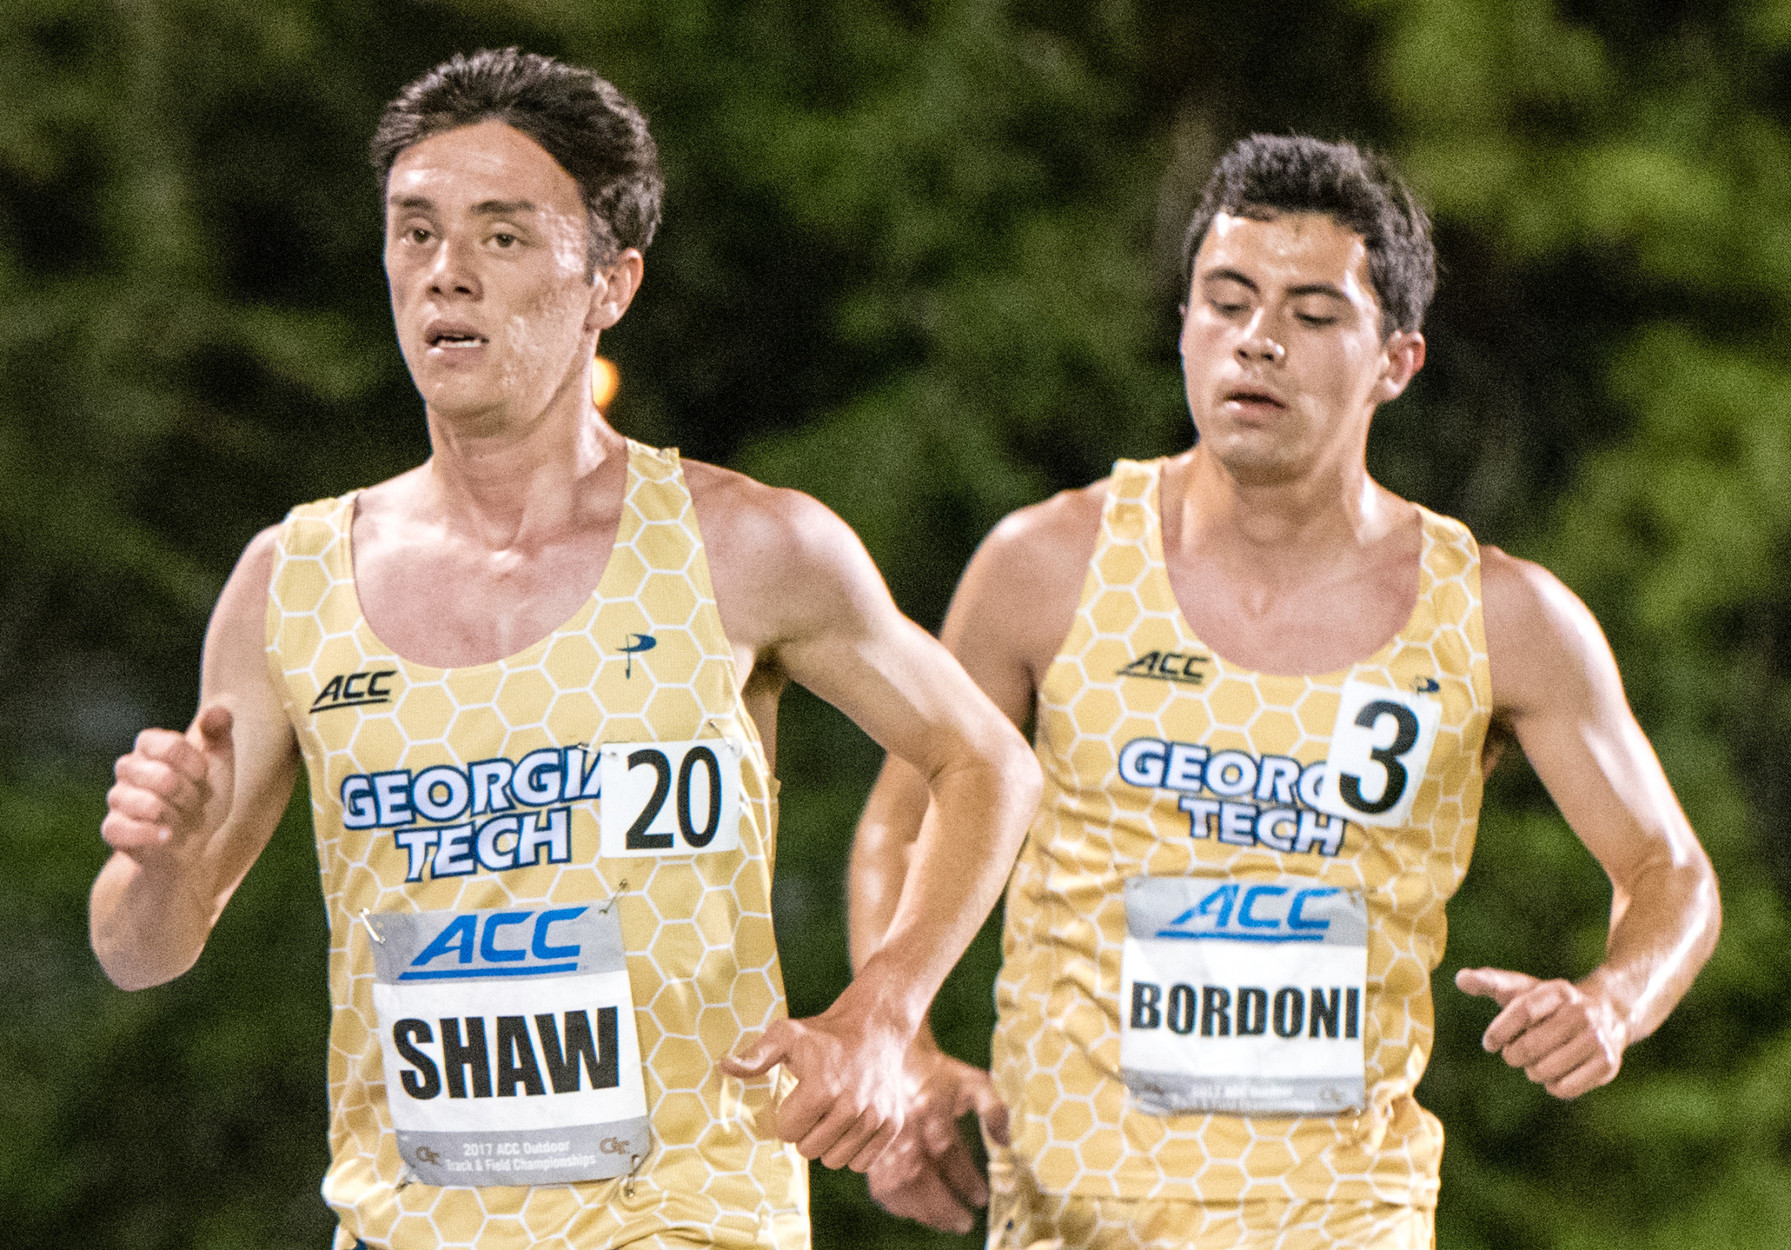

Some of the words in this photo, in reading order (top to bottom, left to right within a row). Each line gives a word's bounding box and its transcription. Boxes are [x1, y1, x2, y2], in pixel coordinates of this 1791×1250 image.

[314, 670, 397, 704] ACC
[1122, 650, 1209, 680] ACC
[1119, 737, 1329, 812] GEORG
[1339, 698, 1421, 815] 3
[625, 746, 722, 850] 20
[1179, 796, 1346, 857] TECH
[396, 803, 571, 882] TECH
[410, 906, 592, 966] ACC
[1169, 884, 1342, 931] ACC
[1129, 979, 1360, 1040] BORDONI
[392, 1006, 620, 1100] SHAW
[445, 1159, 473, 1171] Track
[485, 1158, 511, 1171] Field
[513, 1155, 597, 1171] Championships
[463, 1143, 492, 1156] 2017
[497, 1142, 520, 1155] ACC
[523, 1140, 570, 1154] Outdoor
